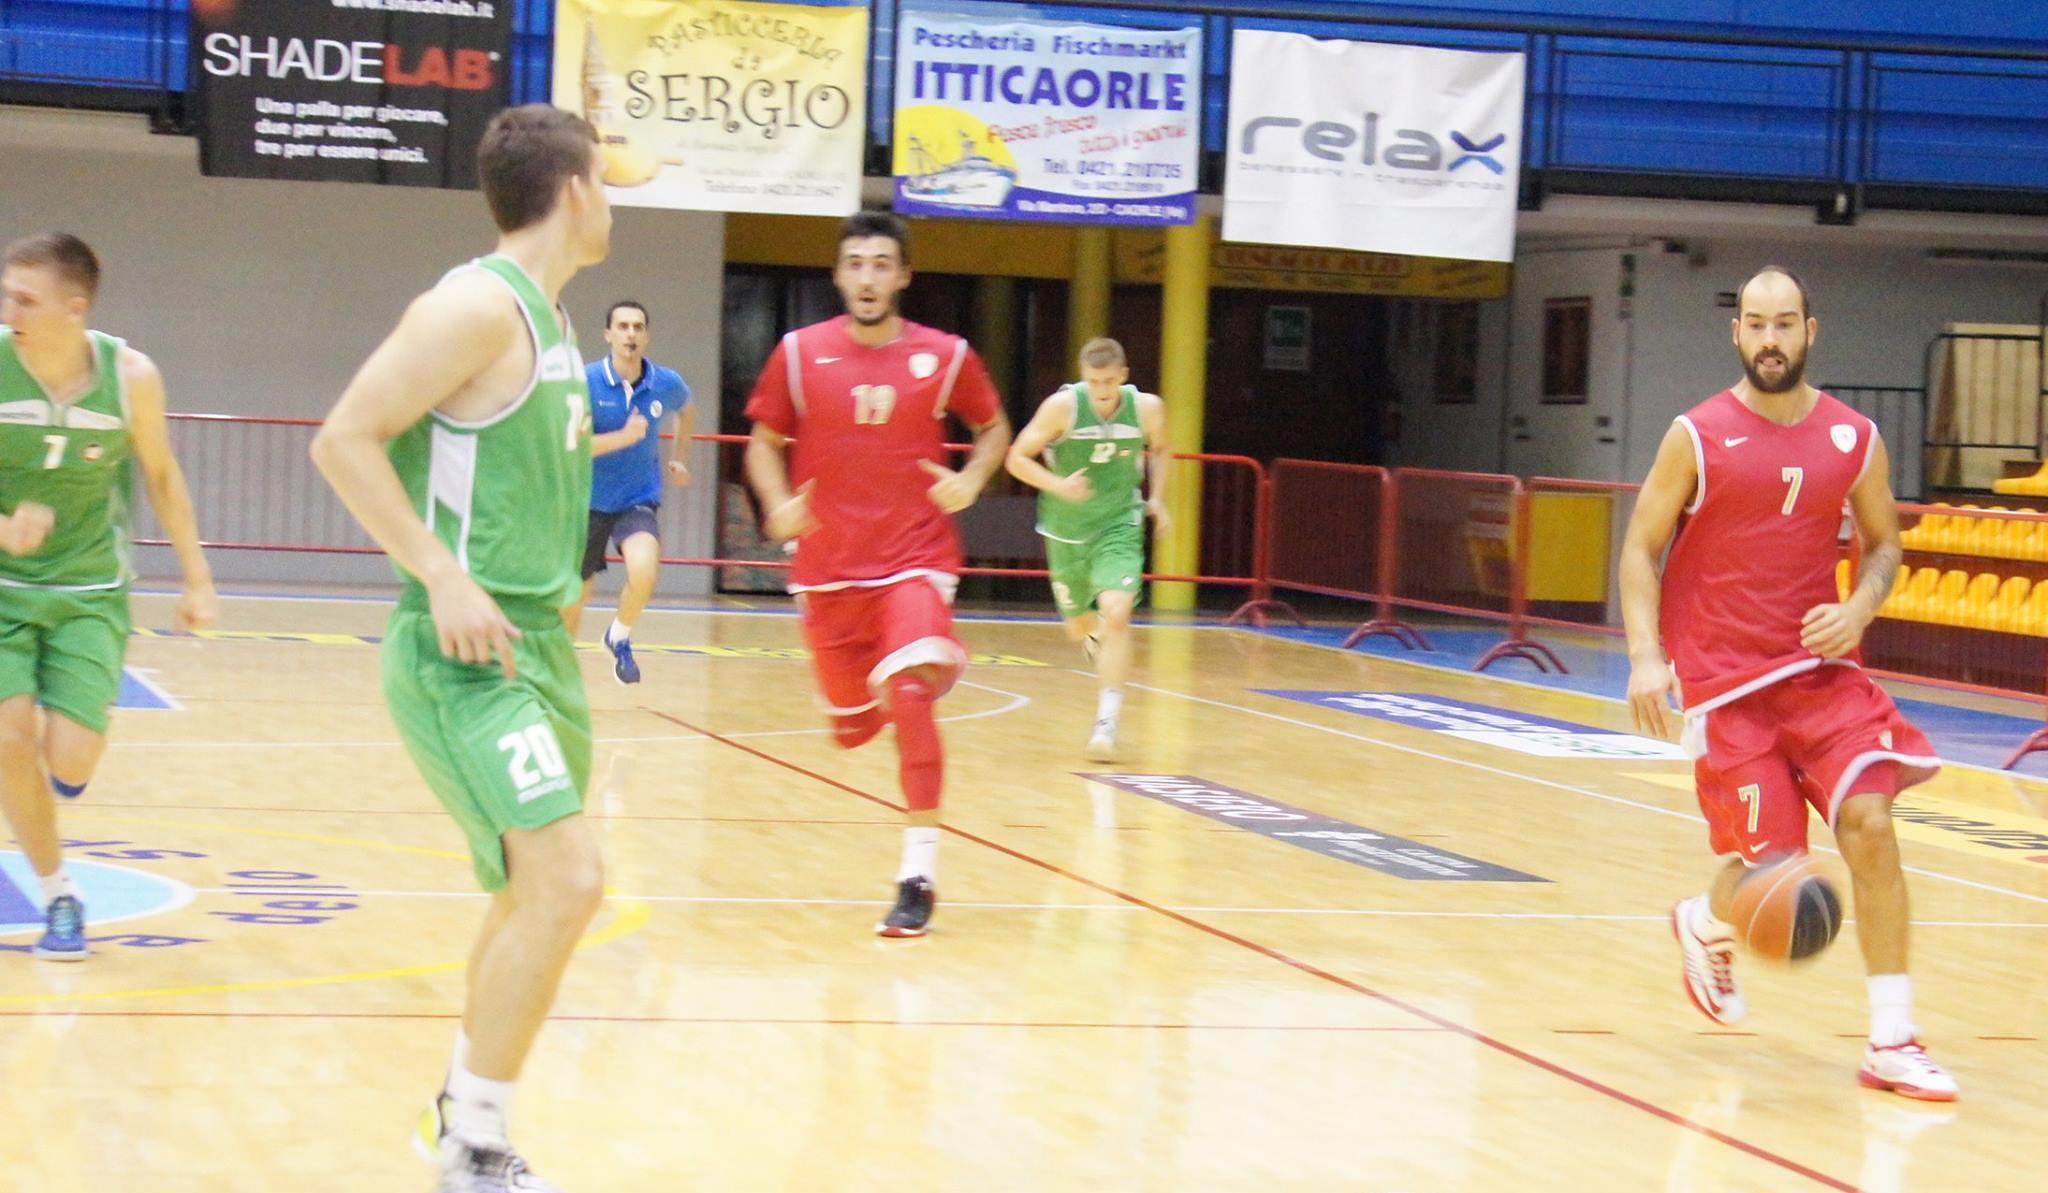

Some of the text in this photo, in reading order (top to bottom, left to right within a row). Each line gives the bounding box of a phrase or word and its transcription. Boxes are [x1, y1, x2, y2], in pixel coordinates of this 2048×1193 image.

[203, 32, 494, 91] SHADELAB
[914, 27, 1187, 59] Pescheria Fischmarkt
[625, 69, 850, 139] SERGIO
[914, 60, 1186, 111] ITTICAORLE
[1241, 111, 1505, 175] relax
[43, 434, 67, 470] 7
[1781, 466, 1803, 516] 7
[497, 723, 566, 791] 20
[1738, 783, 1760, 833] 7
